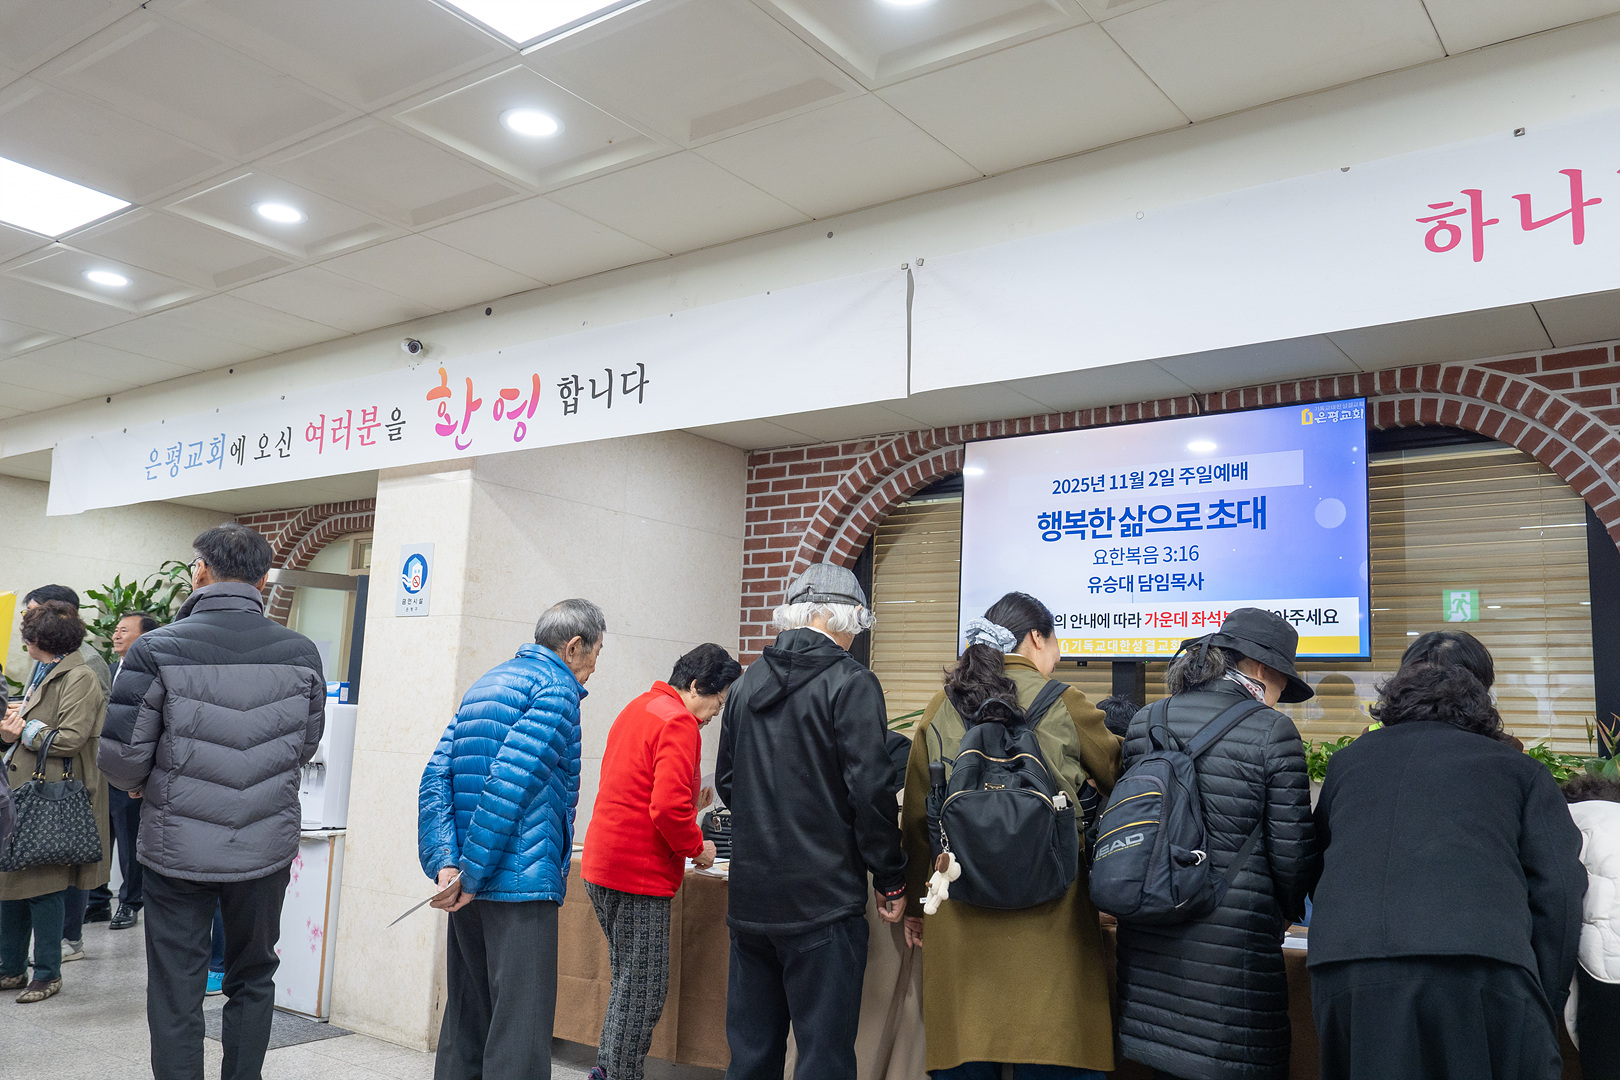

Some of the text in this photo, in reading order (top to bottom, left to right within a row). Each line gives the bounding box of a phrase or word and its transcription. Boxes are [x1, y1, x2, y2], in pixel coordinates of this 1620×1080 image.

[1415, 168, 1620, 263] 하나
[1314, 408, 1364, 424] 은평교회
[253, 426, 293, 461] 오신
[1051, 461, 1249, 495] 2025년 11월 2일 주일예배
[1036, 496, 1268, 542] 행복한 삶으로 초대
[1092, 544, 1200, 566] 요한복음 3:16
[1087, 571, 1205, 594] 유승대 담임목사
[1069, 612, 1110, 629] 안내에
[1113, 611, 1142, 629] 따라
[1144, 611, 1188, 629] 가운데
[1071, 639, 1181, 653] 기독교대한성결교회
